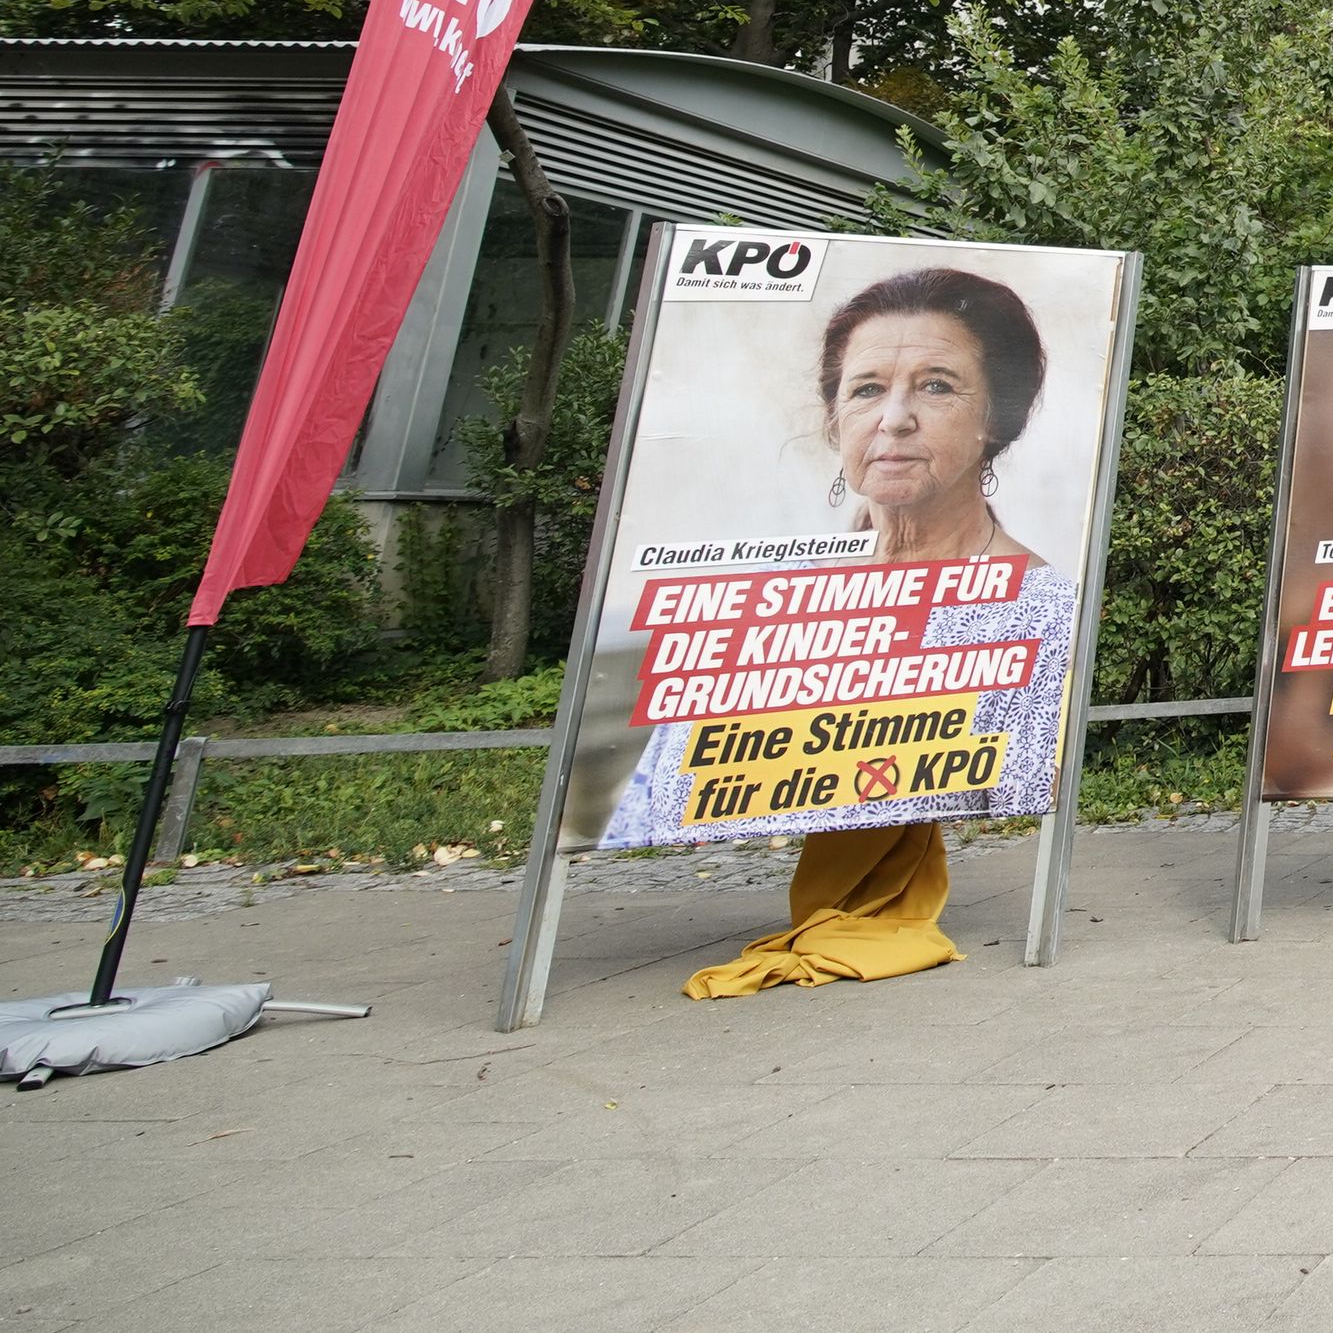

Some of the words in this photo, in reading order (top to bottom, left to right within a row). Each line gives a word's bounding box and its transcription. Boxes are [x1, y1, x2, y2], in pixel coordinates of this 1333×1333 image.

[676, 277, 710, 288] Damit
[712, 278, 737, 289] sich
[740, 282, 762, 290] was
[765, 280, 804, 292] ändert.
[679, 239, 812, 279] KPÖ
[640, 541, 724, 566] Claudia
[730, 535, 869, 562] Krieglsteiner
[646, 579, 747, 626] EINE
[755, 568, 928, 618] STIMME
[932, 555, 1013, 603] FÜR
[650, 628, 733, 674] DIE
[738, 616, 909, 666] KINDER-
[646, 646, 1030, 720] GRUNDSICHERUNG
[689, 722, 793, 768] Eine
[803, 708, 967, 755] Stimme
[694, 772, 761, 820] für
[769, 768, 838, 810] die
[909, 737, 999, 792] KPÖ
